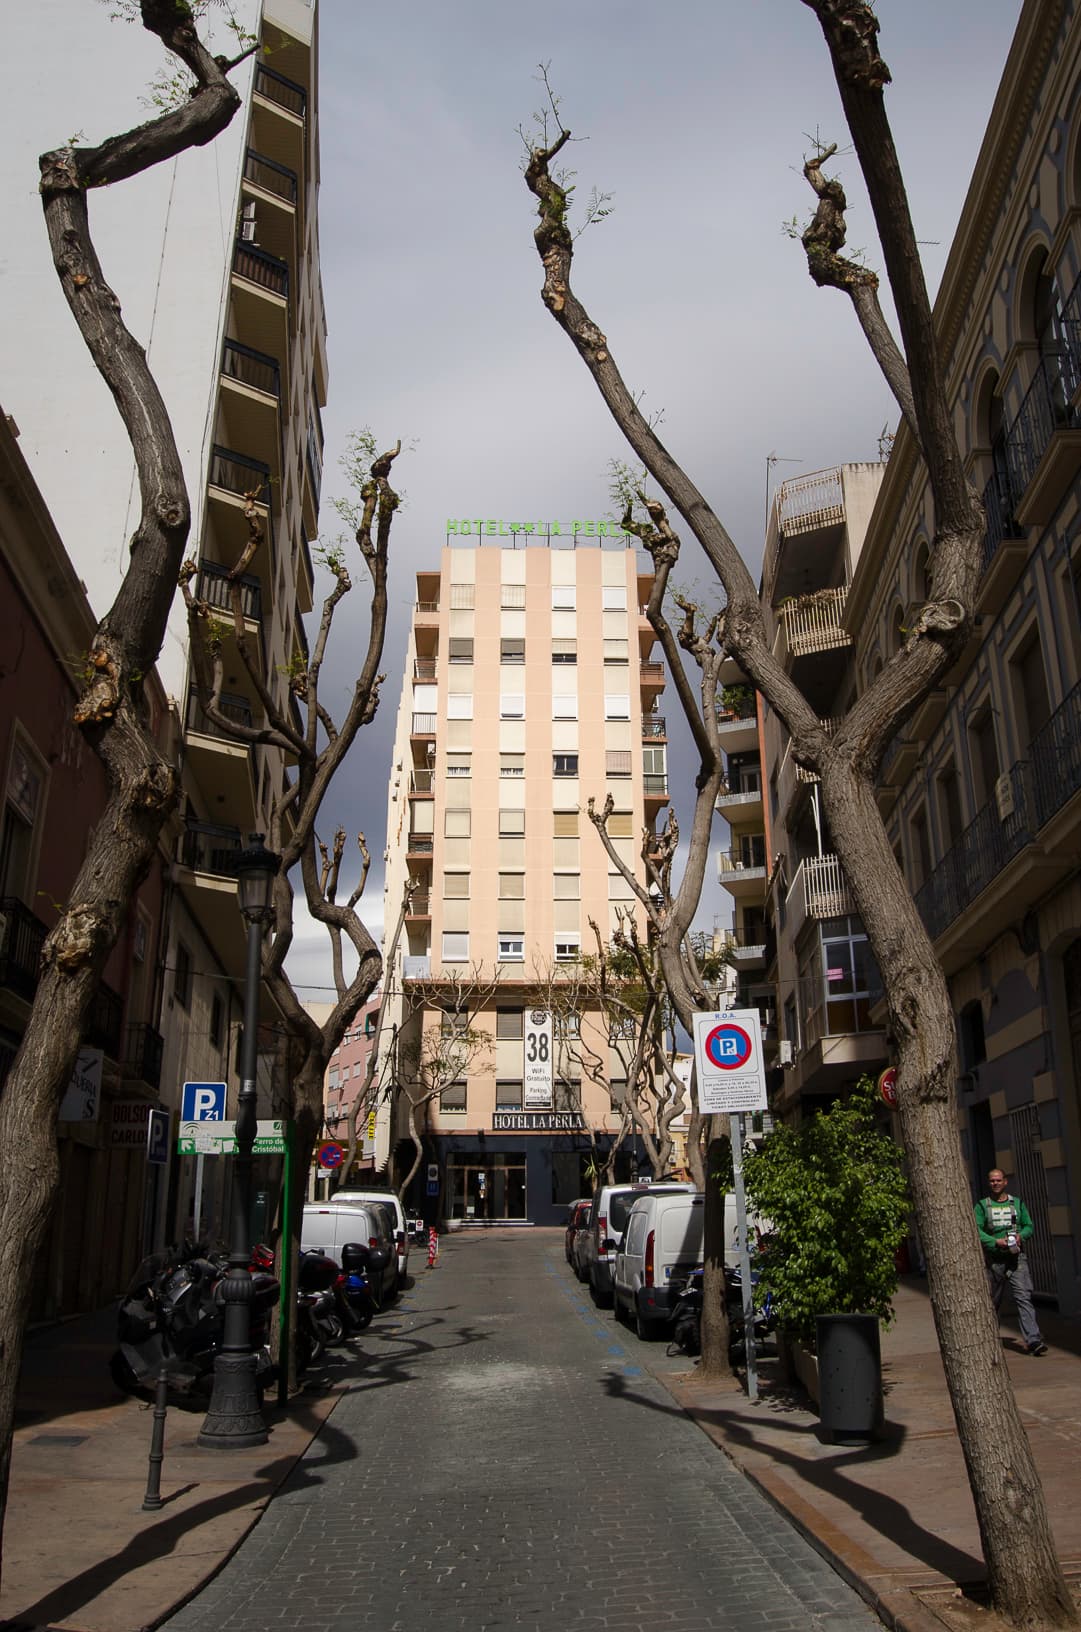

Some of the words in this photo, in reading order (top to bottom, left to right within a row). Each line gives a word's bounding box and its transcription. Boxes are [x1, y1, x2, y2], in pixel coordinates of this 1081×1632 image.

[446, 519, 509, 535] HOTEL
[537, 520, 561, 536] LA
[527, 1032, 549, 1063] 38
[723, 1040, 734, 1054] P
[526, 1075, 551, 1083] Gratuito
[193, 1088, 216, 1121] P
[205, 1110, 220, 1121] Z1
[494, 1114, 530, 1129] HOTEL
[533, 1114, 546, 1129] LA
[548, 1114, 582, 1129] PERLA
[112, 1129, 147, 1144] CARLO
[251, 1145, 284, 1153] Cristóbal
